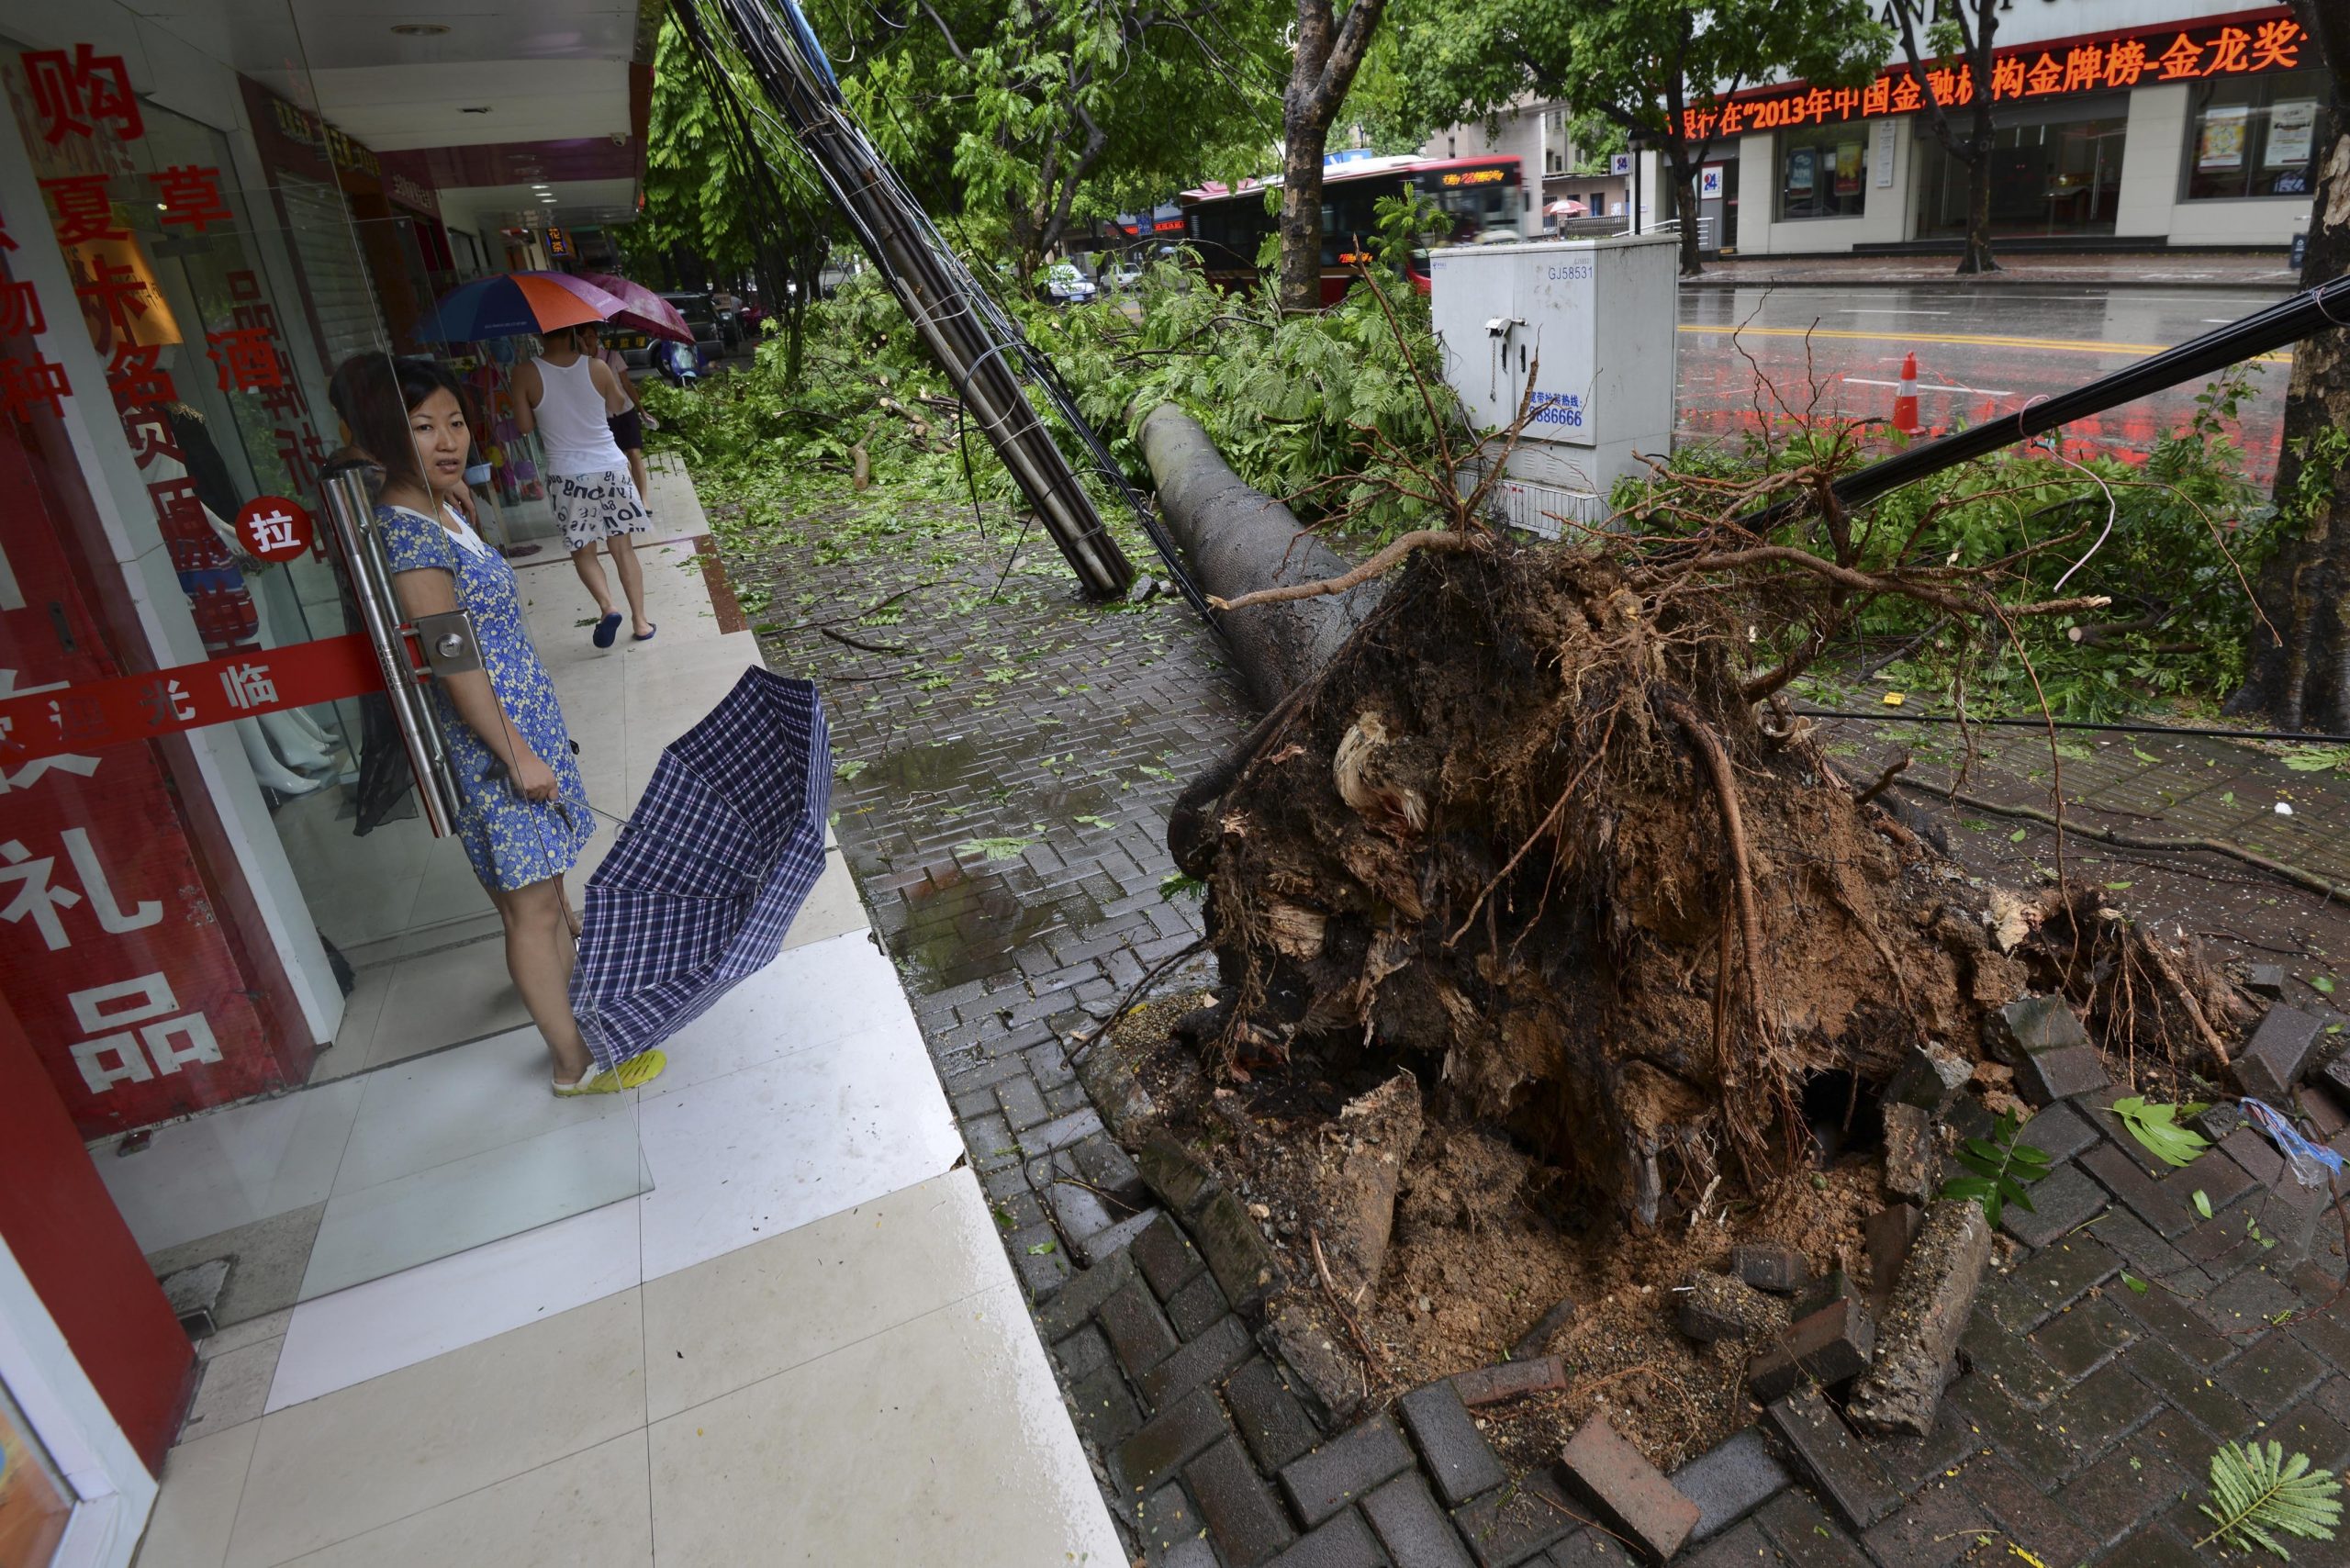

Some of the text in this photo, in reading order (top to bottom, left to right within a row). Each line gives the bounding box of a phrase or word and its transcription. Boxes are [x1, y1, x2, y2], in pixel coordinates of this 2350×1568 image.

[20, 43, 144, 145] 购
[1548, 266, 1593, 280] GJ58531
[250, 510, 301, 553] 拉
